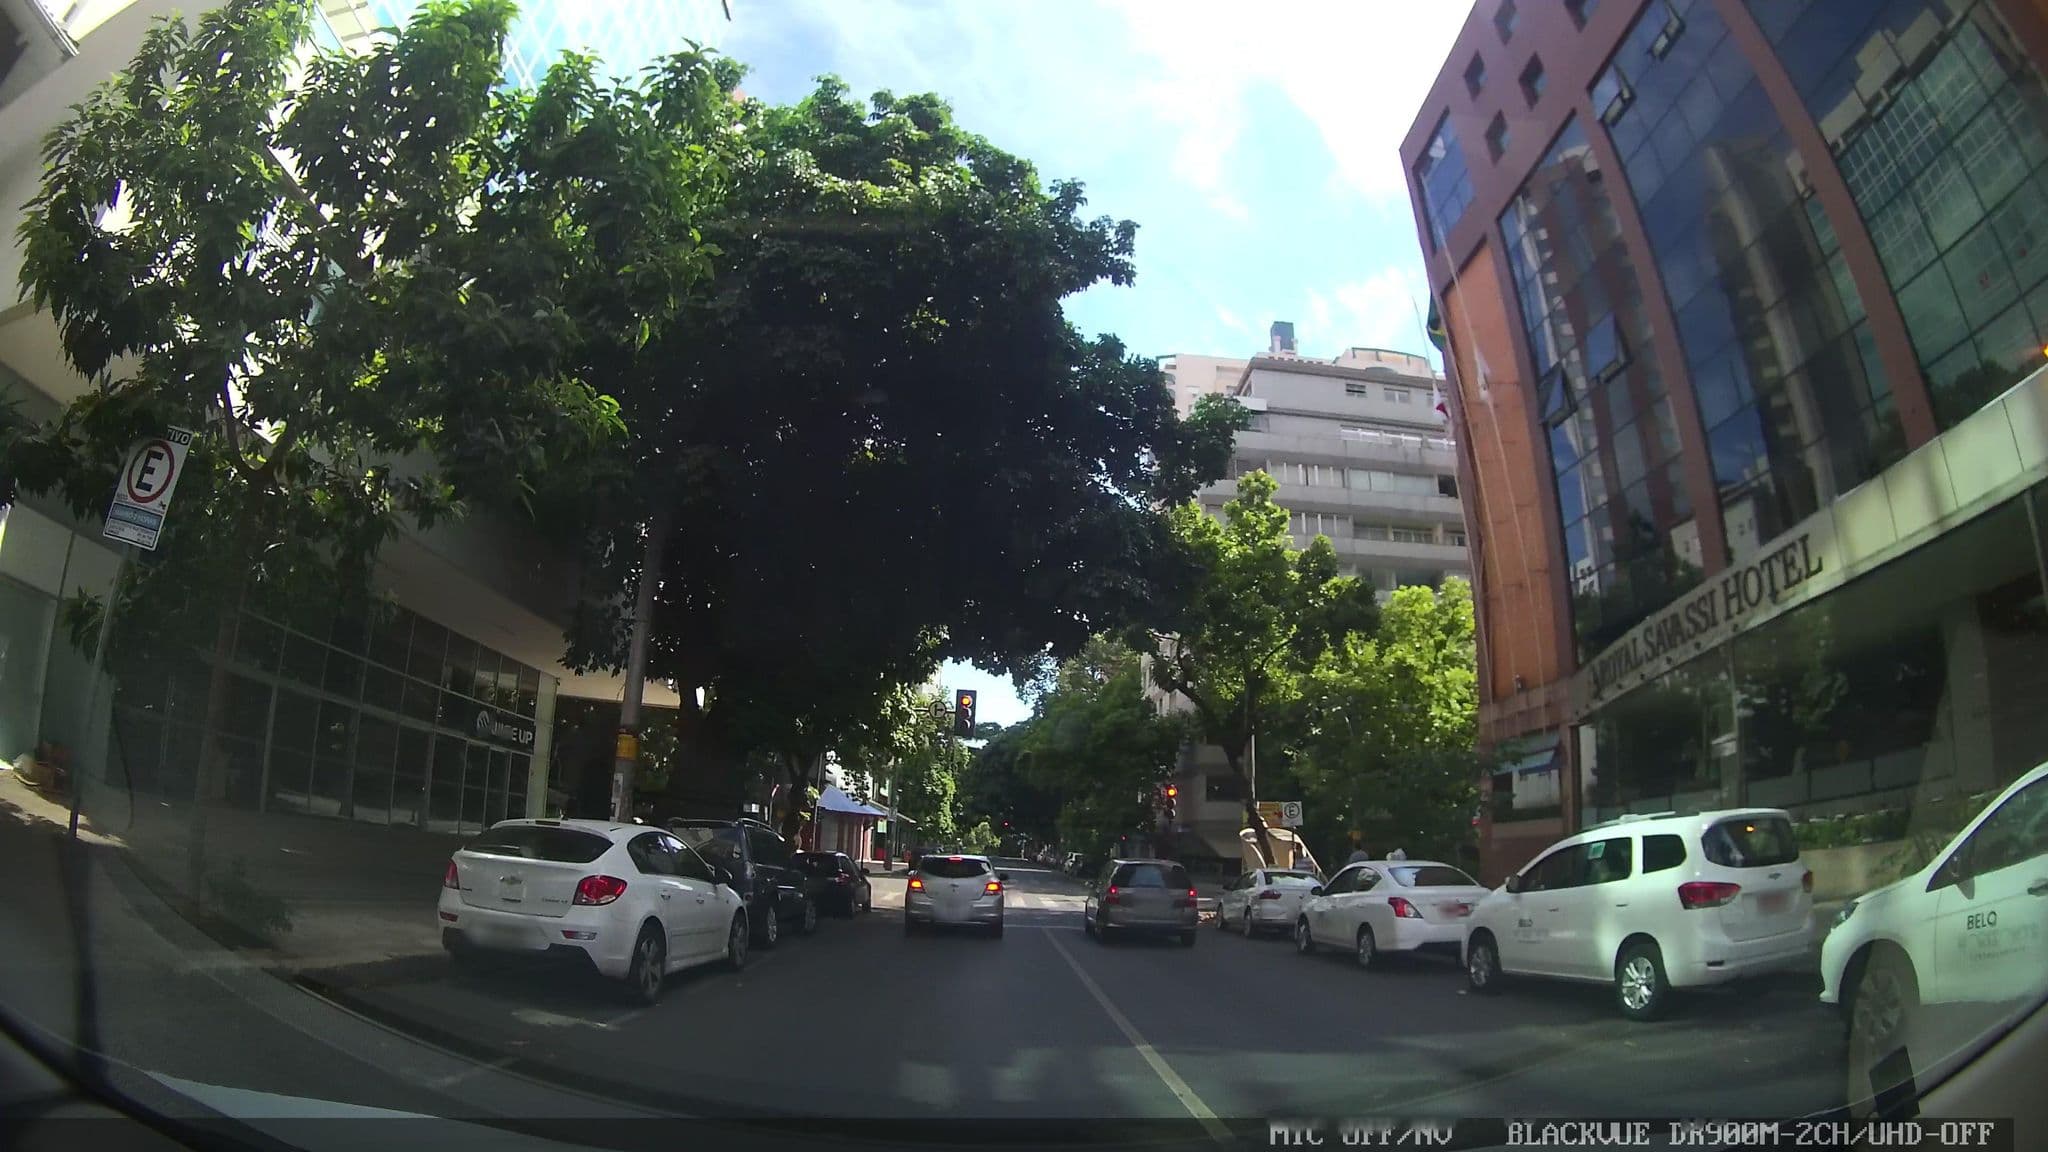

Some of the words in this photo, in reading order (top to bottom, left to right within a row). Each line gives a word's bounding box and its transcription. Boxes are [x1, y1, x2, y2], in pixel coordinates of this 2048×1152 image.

[136, 449, 164, 492] E
[1642, 588, 1719, 661] SAVASSI
[1720, 534, 1824, 622] HOTEL
[1967, 910, 1997, 930] BELO
